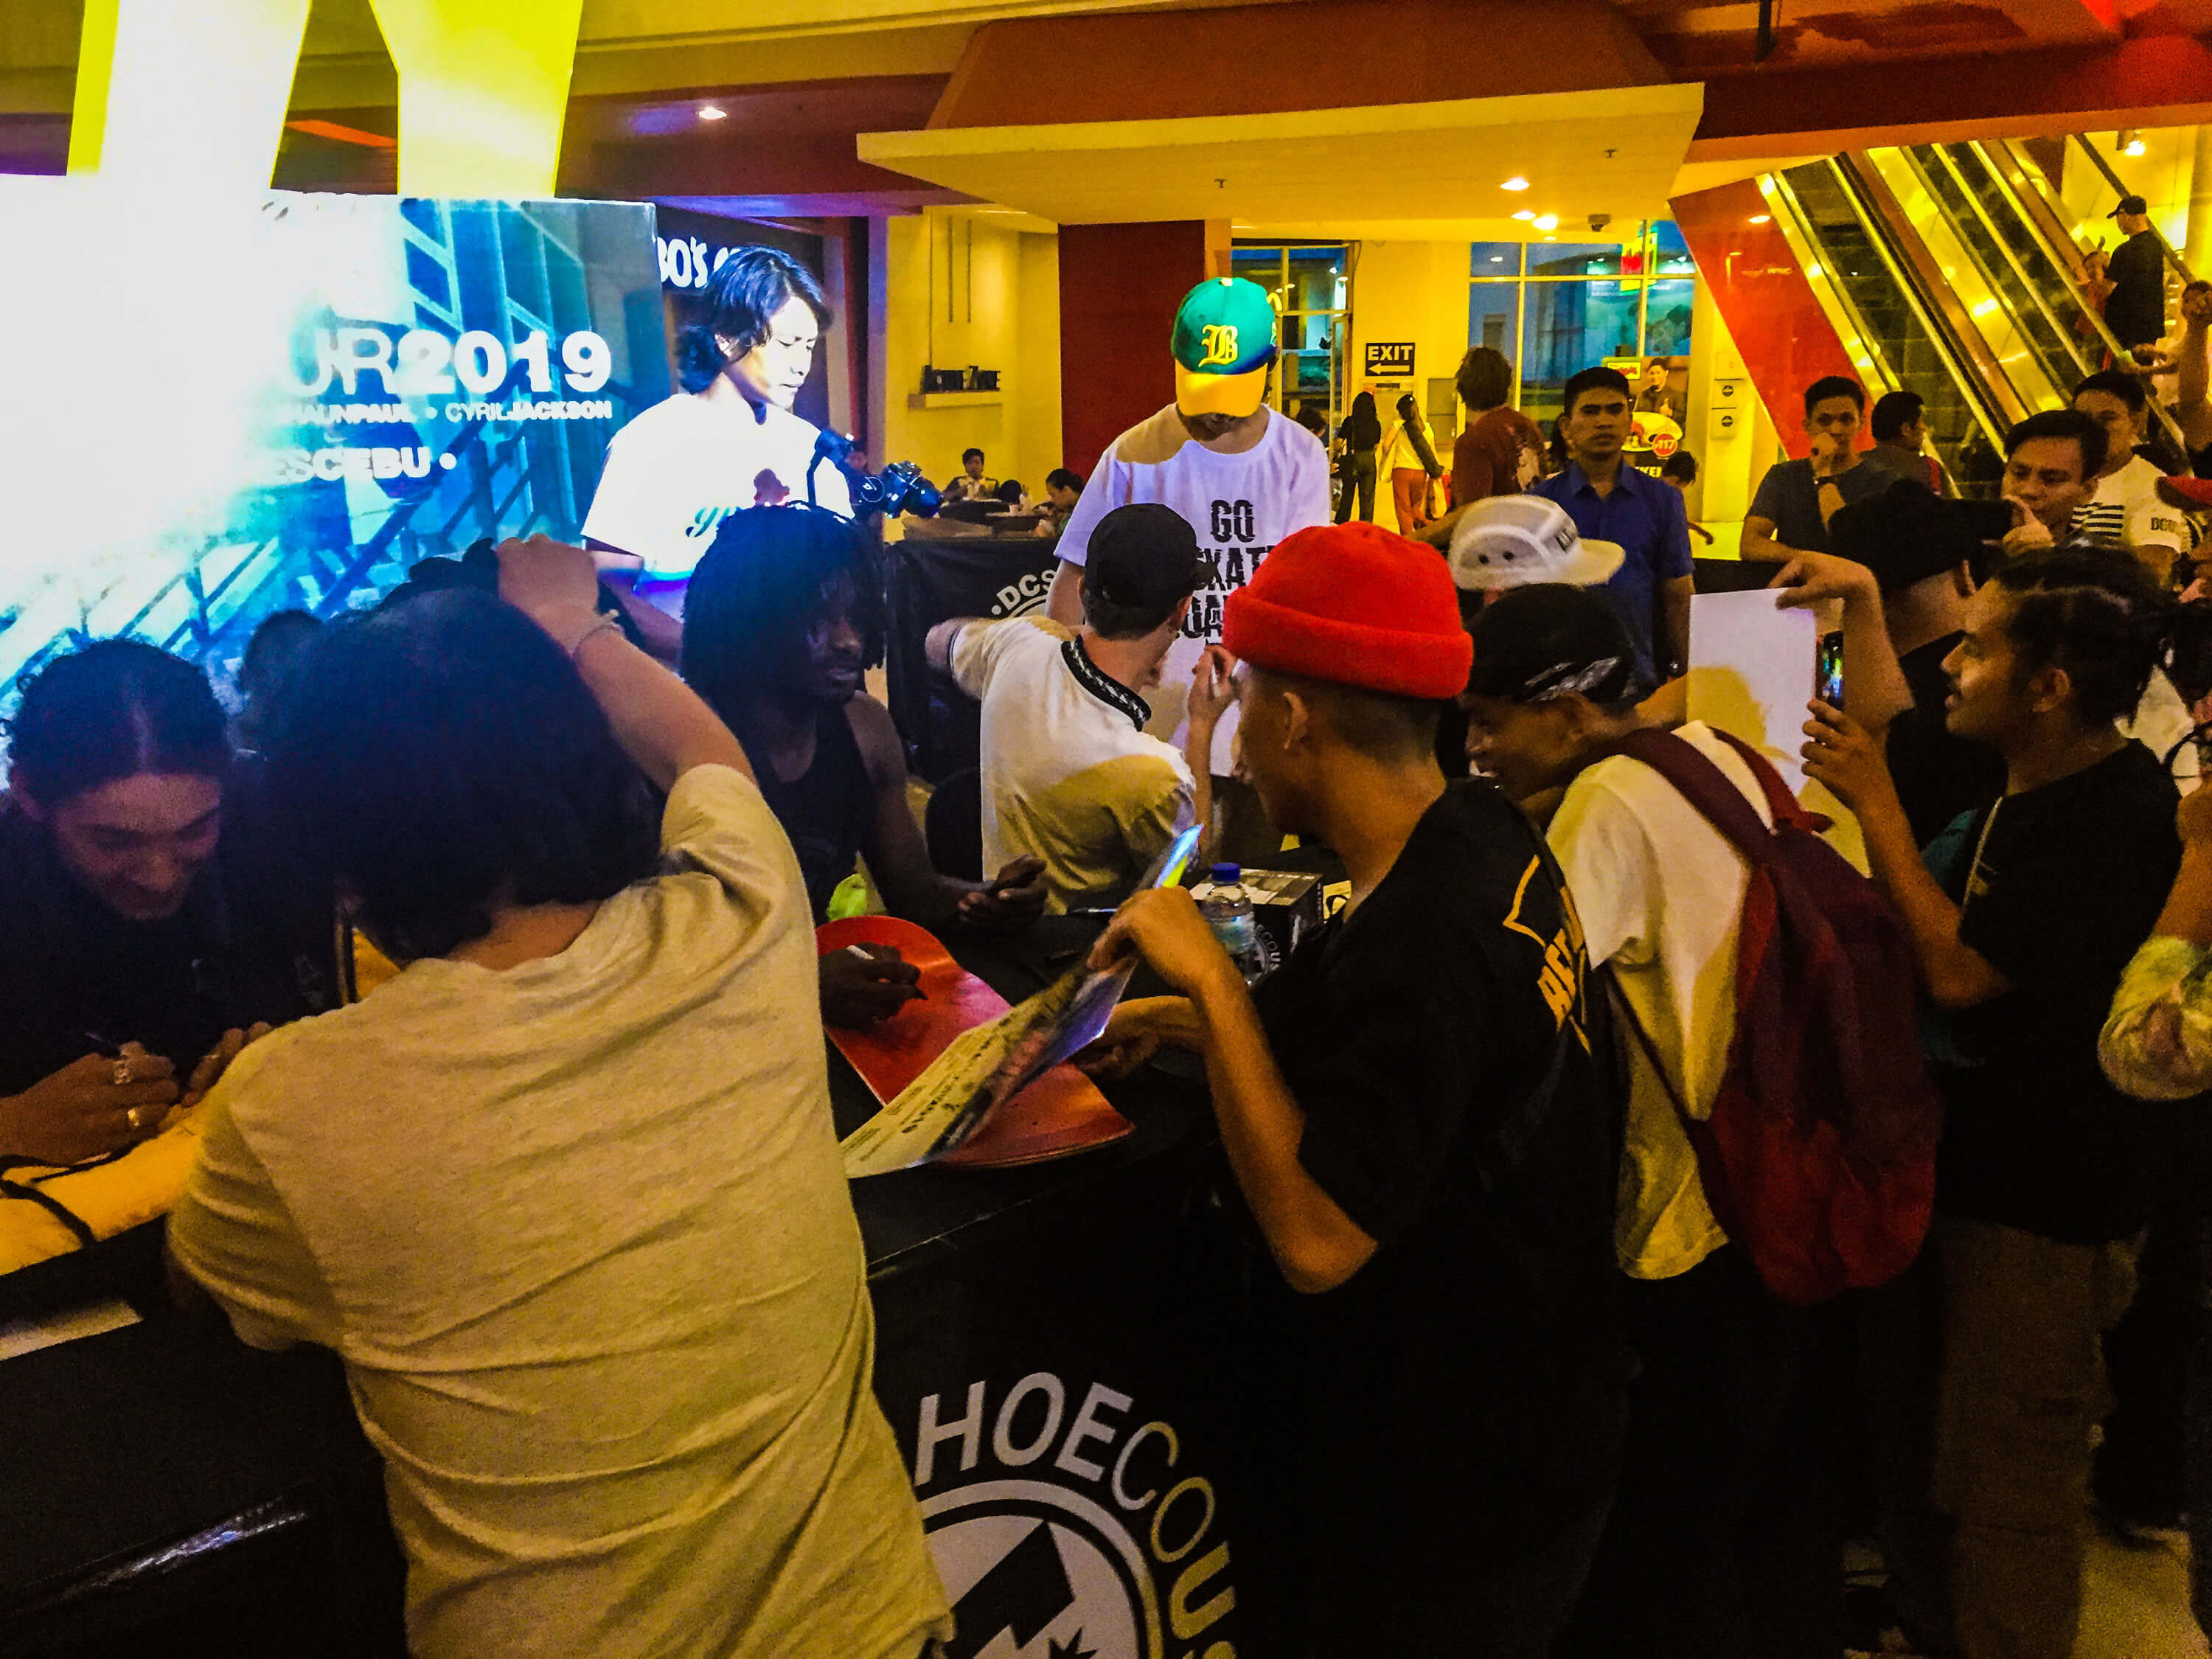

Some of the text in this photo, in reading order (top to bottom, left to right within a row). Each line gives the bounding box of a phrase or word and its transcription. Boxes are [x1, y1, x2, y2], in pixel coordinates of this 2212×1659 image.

[1368, 345, 1413, 361] EXIT
[1210, 499, 1255, 543] GO
[914, 1371, 1237, 1659] HOECOU
